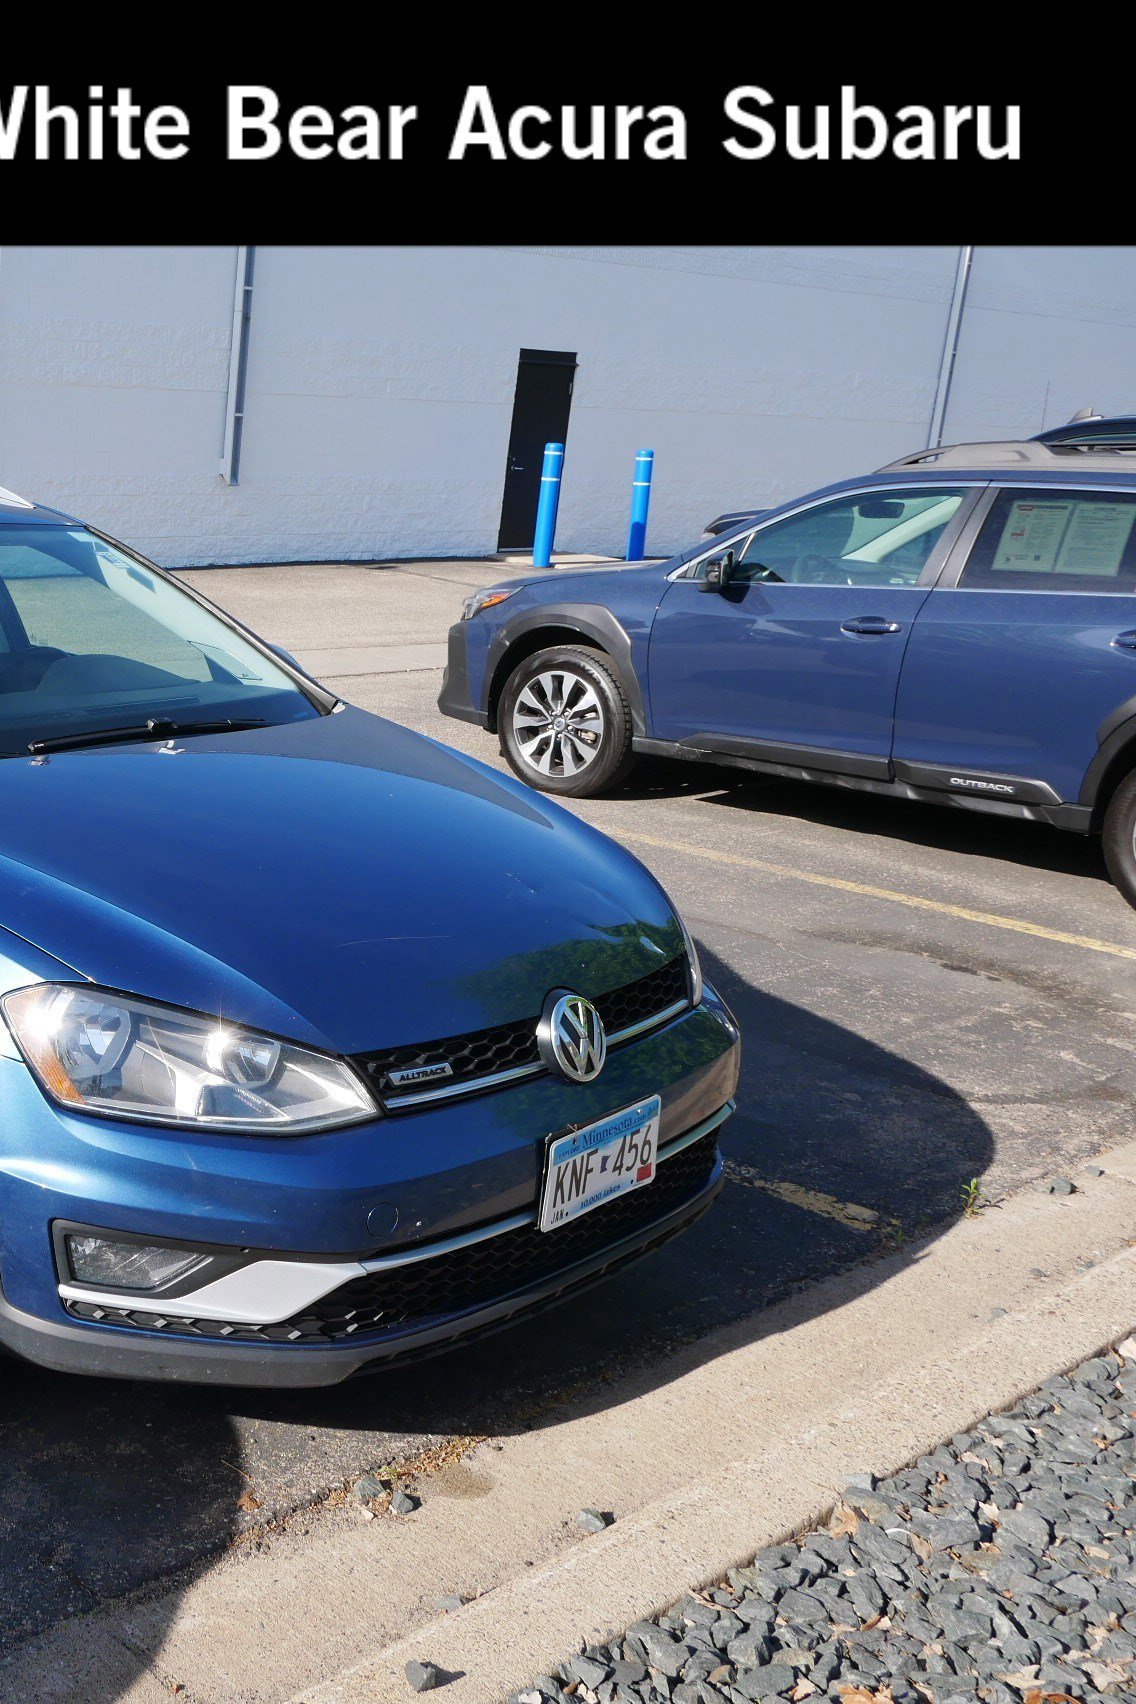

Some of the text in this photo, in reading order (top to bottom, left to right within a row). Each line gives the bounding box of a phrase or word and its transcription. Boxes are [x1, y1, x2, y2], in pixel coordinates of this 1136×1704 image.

[950, 777, 1015, 793] OUTBACK
[399, 1066, 446, 1082] ALLTRACK
[552, 1123, 651, 1209] KNF 456
[550, 1208, 565, 1224] JAN
